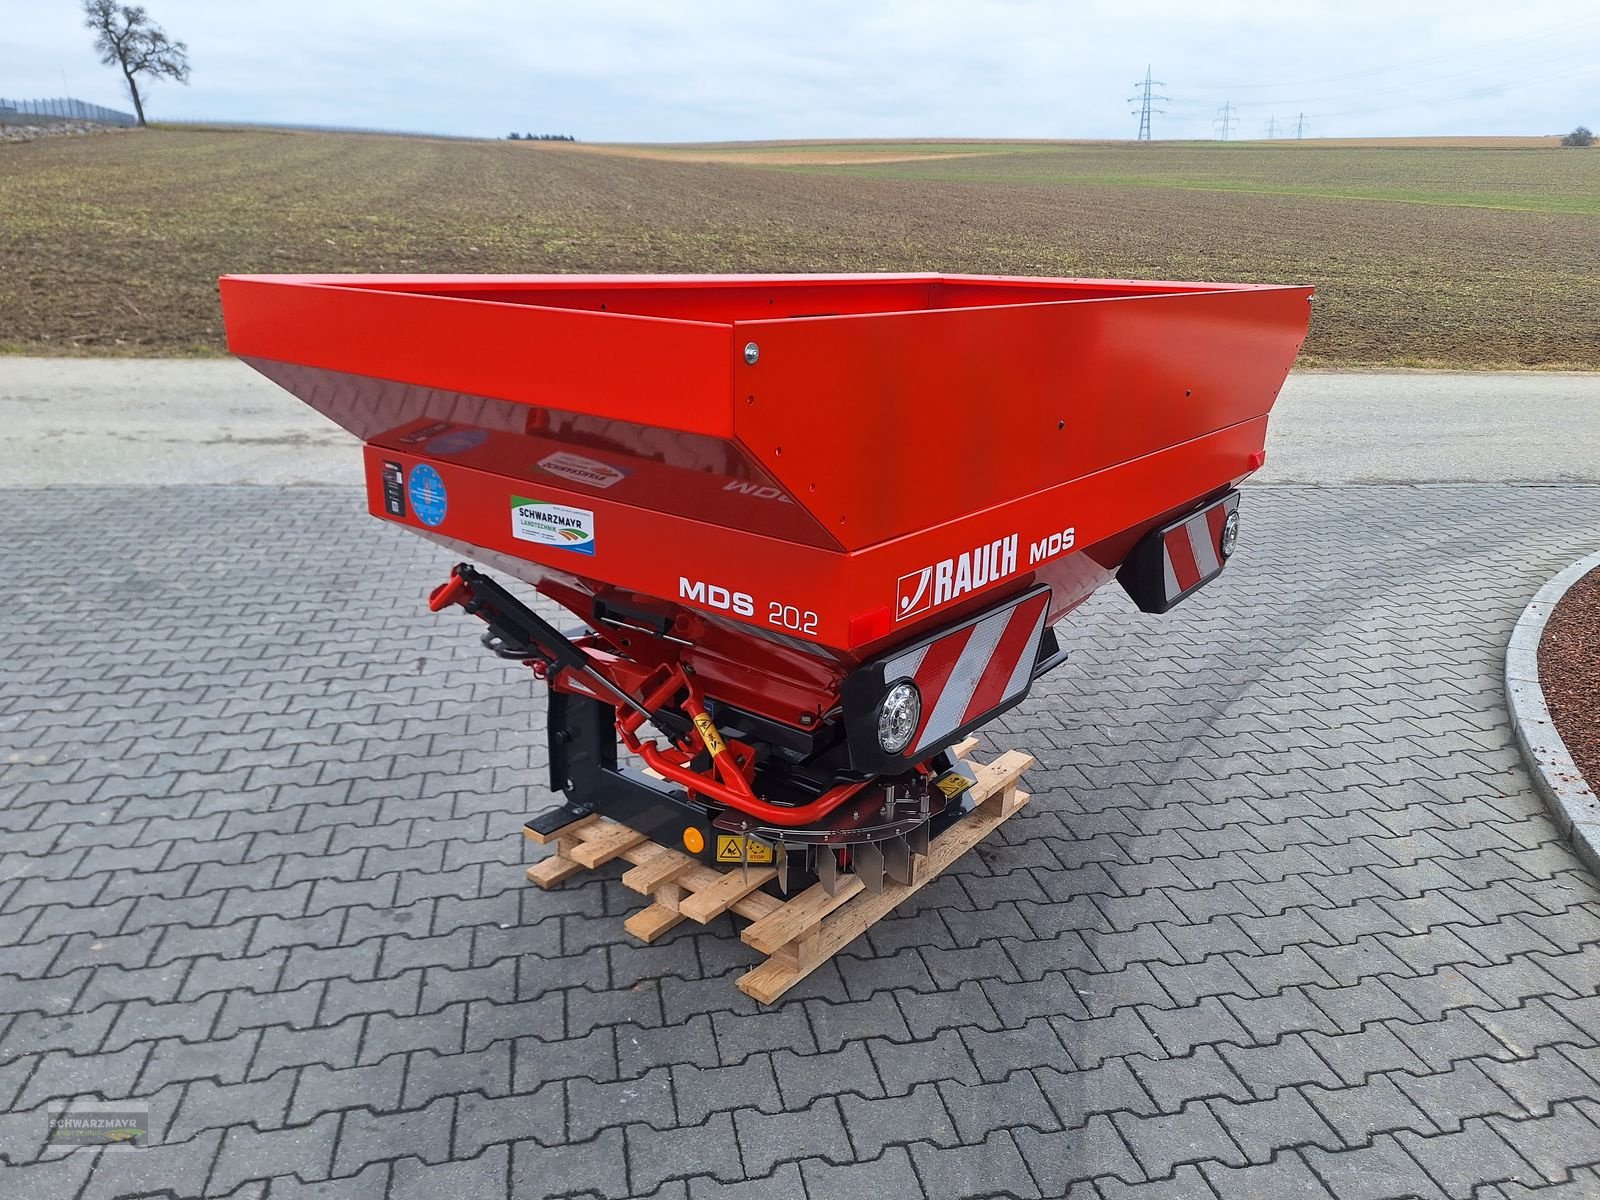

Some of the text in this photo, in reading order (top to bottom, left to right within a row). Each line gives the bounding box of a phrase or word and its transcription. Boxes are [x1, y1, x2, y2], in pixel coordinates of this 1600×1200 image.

[519, 507, 582, 529] SCHWARZMAYR
[520, 519, 557, 533] LANDTECHNIK
[933, 527, 1076, 606] RAUCH MDS
[679, 576, 819, 636] MDS 20.2
